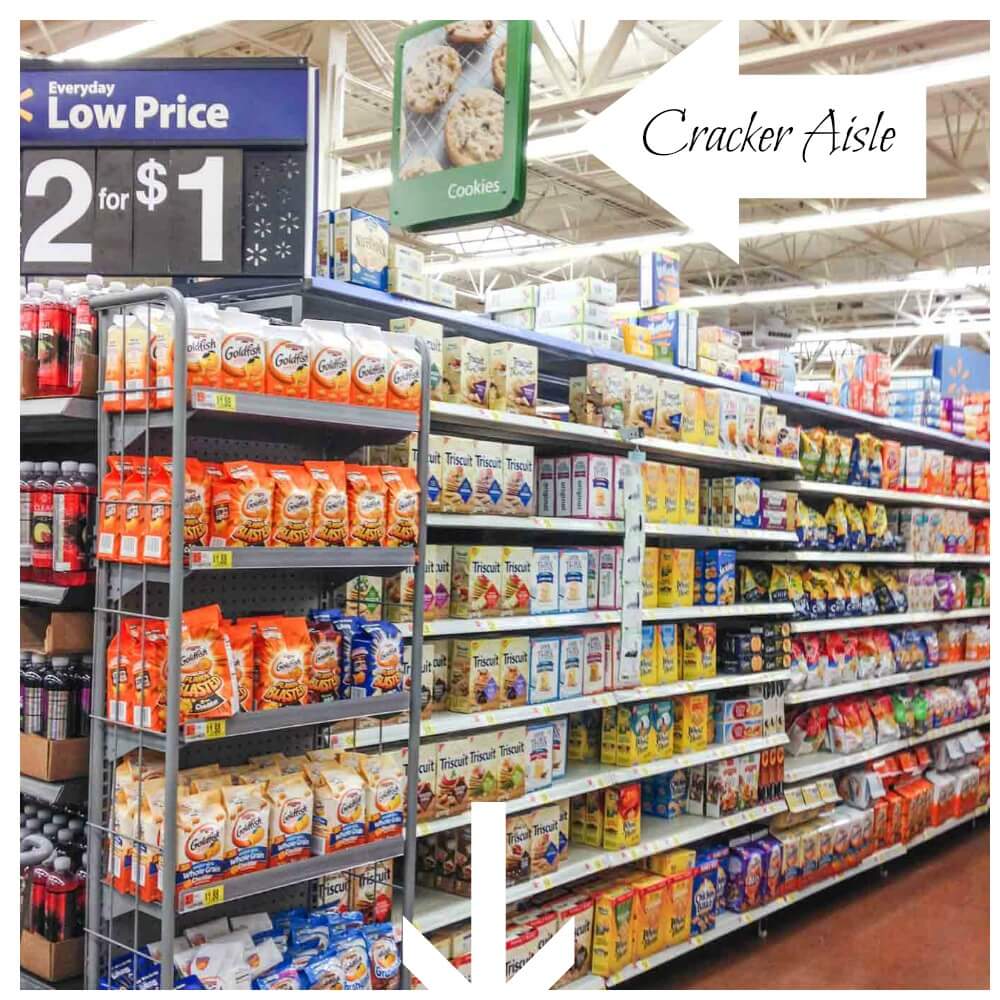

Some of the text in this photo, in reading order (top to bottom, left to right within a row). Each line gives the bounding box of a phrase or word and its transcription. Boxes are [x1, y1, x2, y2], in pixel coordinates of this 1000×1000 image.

[48, 80, 114, 96] Everyday
[48, 95, 229, 129] Low Price
[448, 181, 499, 198] Cookies
[23, 158, 93, 262] 2
[98, 188, 129, 210] for
[225, 344, 261, 360] Goldfish
[318, 358, 347, 372] Goldfish
[359, 365, 384, 378] Goldfish
[394, 371, 419, 383] Goldfish
[445, 452, 472, 467] Triscuit
[475, 455, 501, 468] Triscuit
[506, 458, 532, 472] Triscuit
[473, 561, 500, 573] Triscuit
[505, 561, 530, 573] Triscuit
[474, 655, 498, 668] Triscuit
[504, 653, 527, 664] Triscuit
[470, 750, 496, 763] Triscuit
[499, 743, 524, 756] Triscuit
[440, 754, 468, 770] Triscuit
[533, 820, 558, 837] Triscuit
[191, 832, 219, 850] Goldfish
